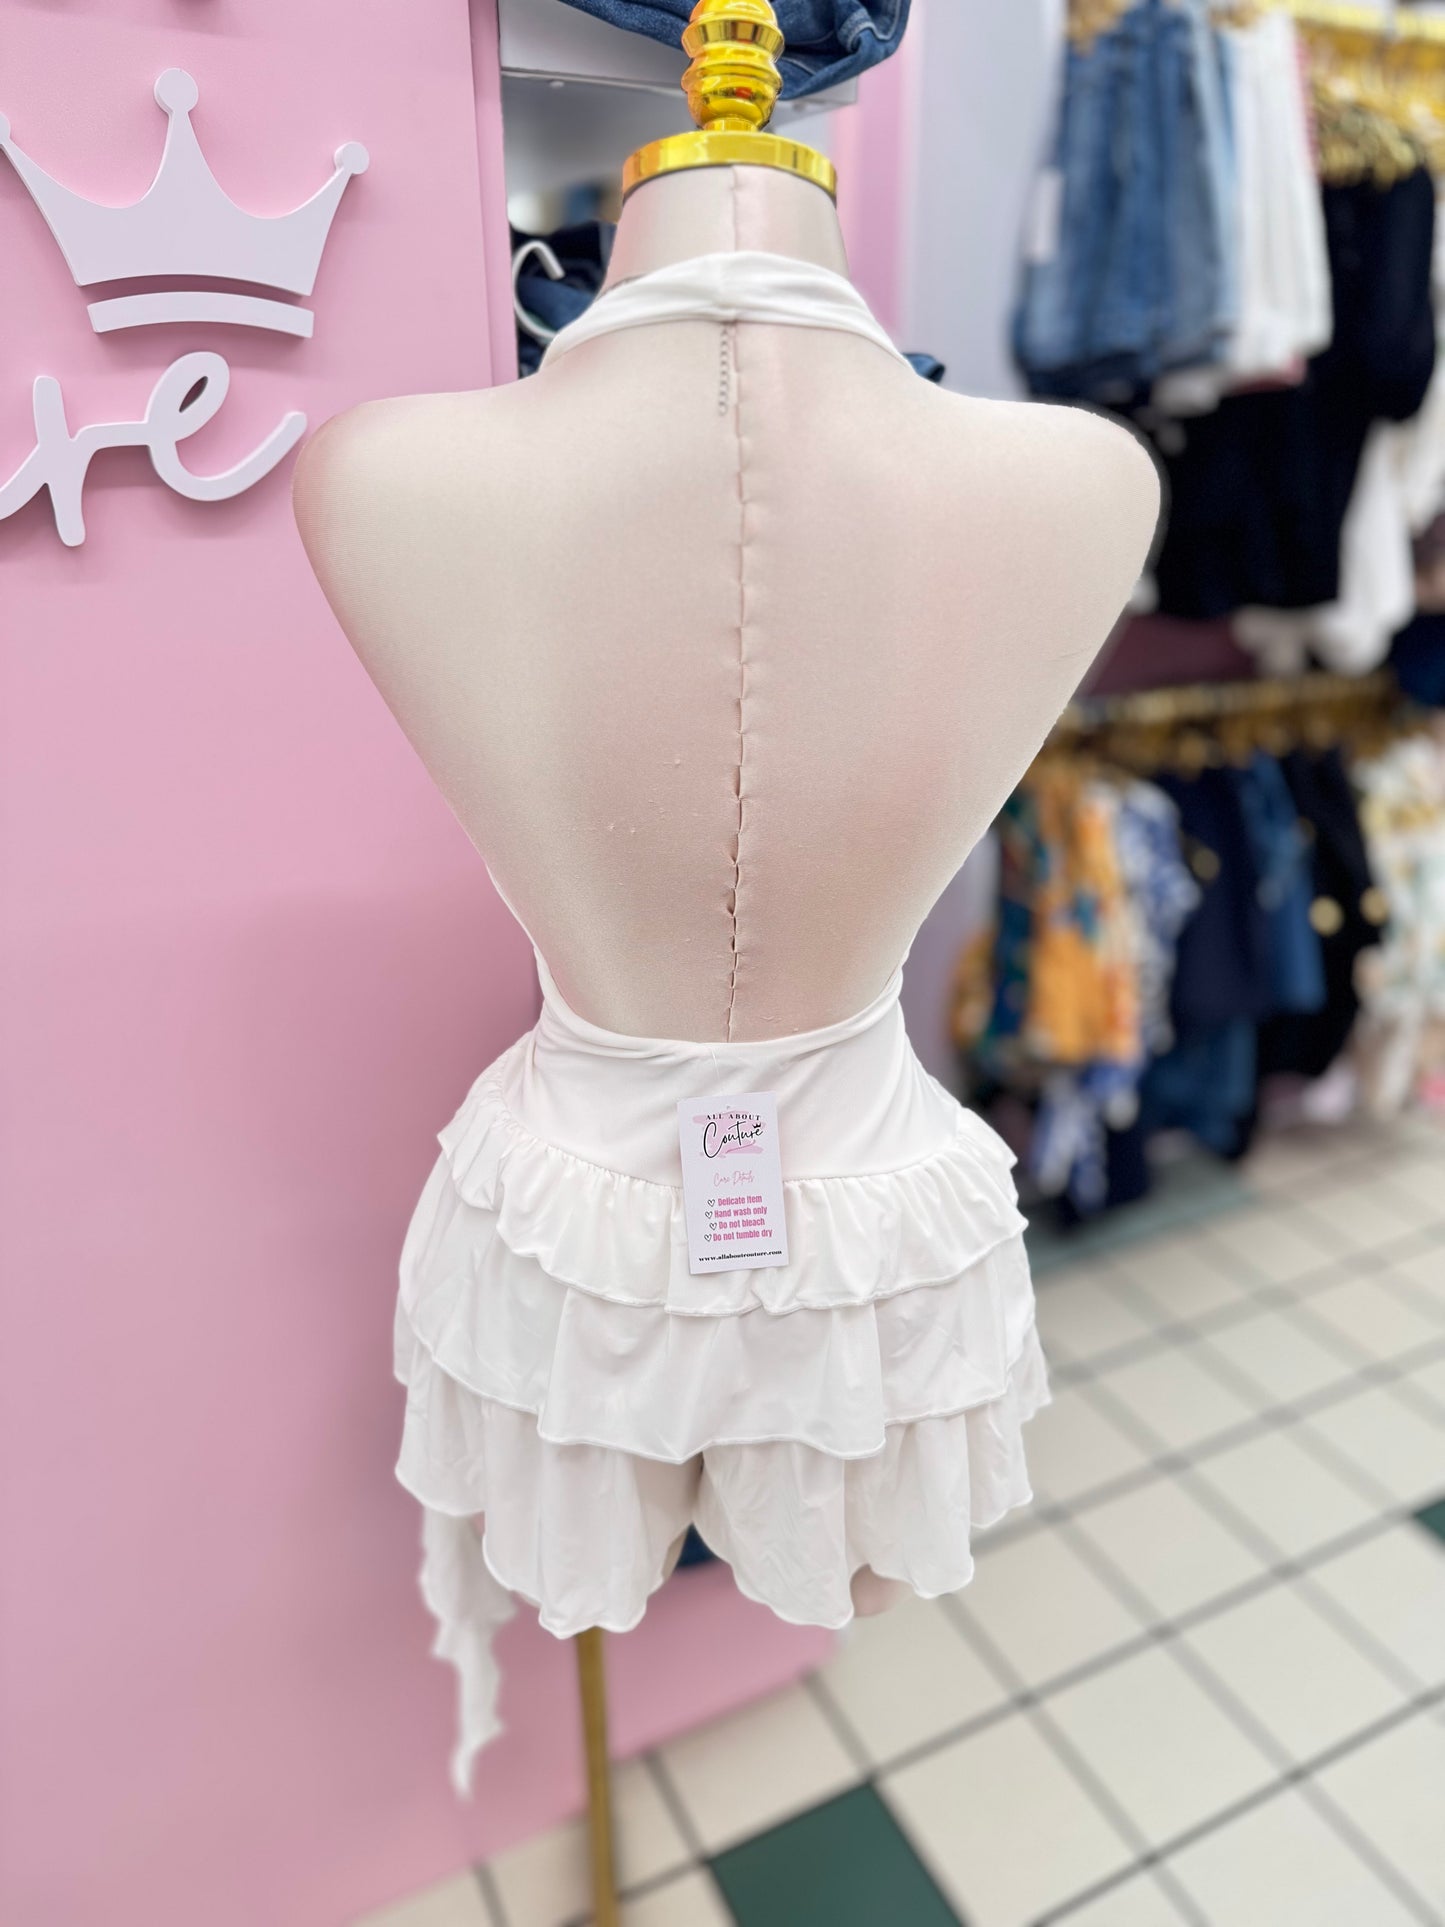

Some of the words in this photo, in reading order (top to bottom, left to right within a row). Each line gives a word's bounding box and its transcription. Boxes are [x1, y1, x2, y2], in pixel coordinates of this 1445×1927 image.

[703, 1121, 763, 1158] Couture
[718, 1197, 745, 1206] Delicate
[714, 1210, 731, 1218] Hand
[733, 1207, 751, 1216] wash
[753, 1206, 767, 1215] only
[719, 1221, 727, 1229] Do
[729, 1220, 740, 1228] not
[742, 1218, 765, 1227] bleach
[713, 1233, 721, 1241] Do
[723, 1232, 734, 1240] not
[736, 1230, 760, 1239] tumble
[761, 1229, 772, 1238] dry
